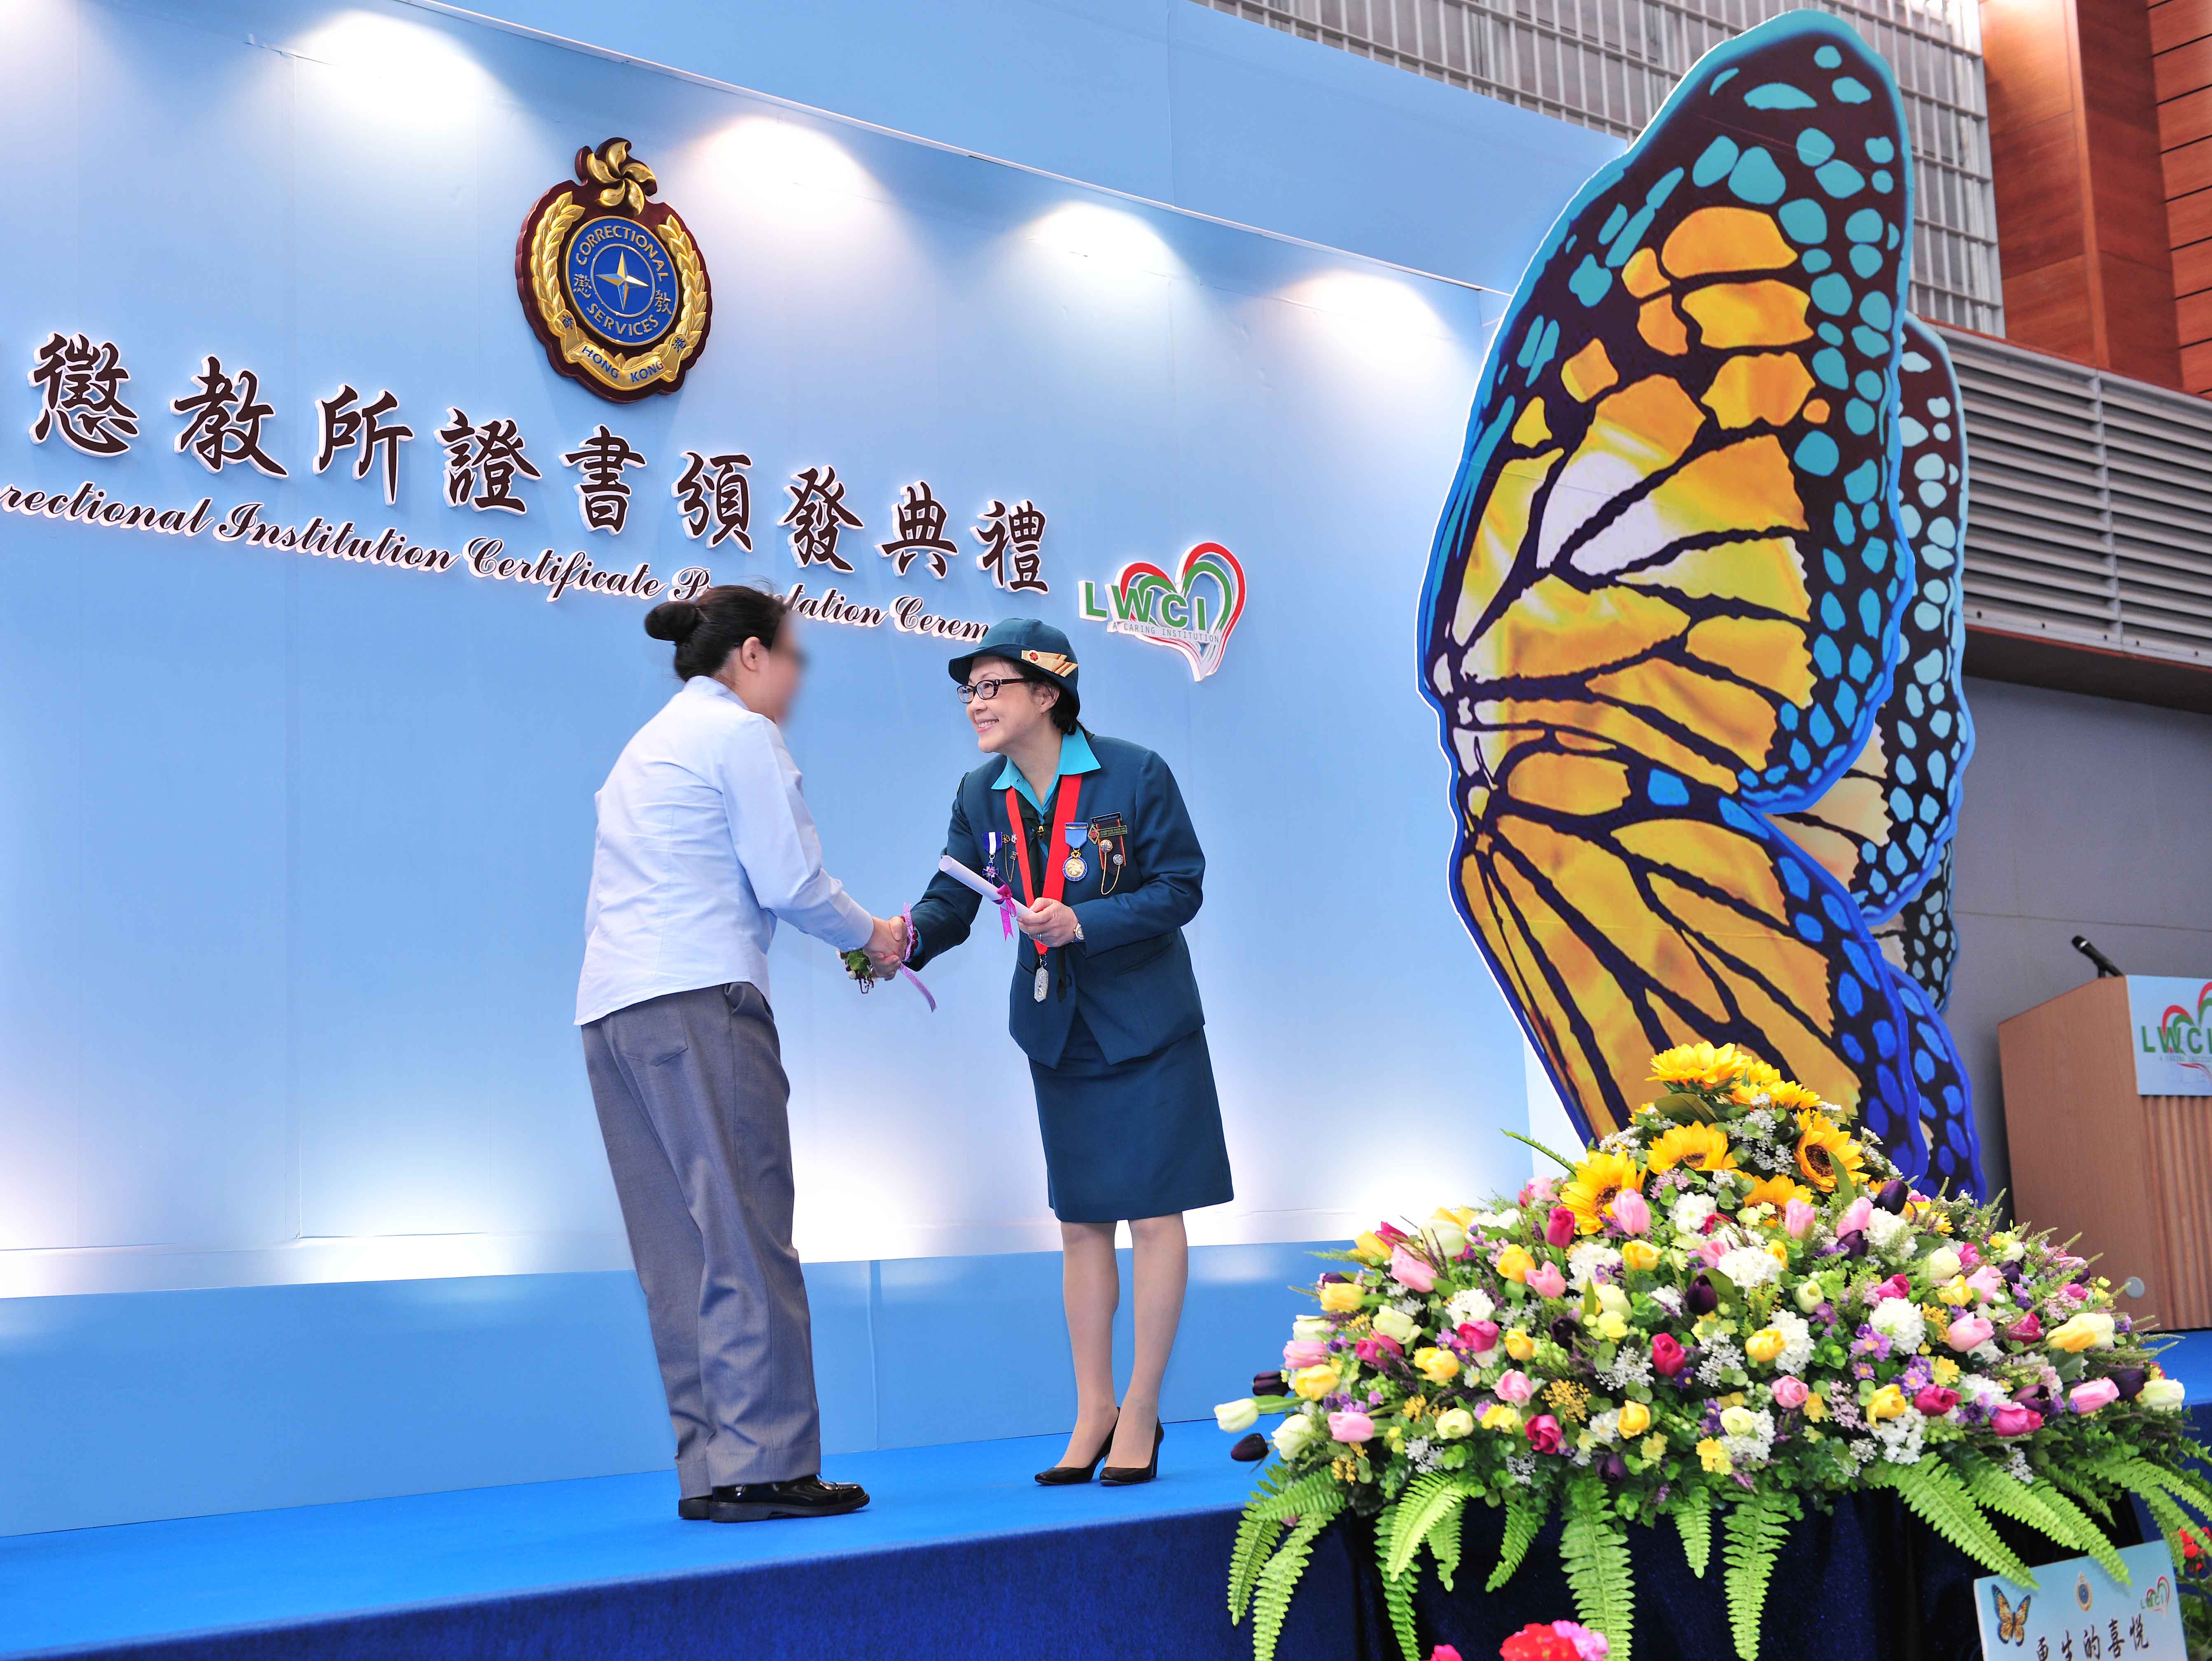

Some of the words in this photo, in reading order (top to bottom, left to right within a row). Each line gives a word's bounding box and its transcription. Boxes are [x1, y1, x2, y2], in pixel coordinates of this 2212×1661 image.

[576, 225, 669, 282] CORRECTIONAL
[587, 303, 659, 337] SERVICES
[655, 290, 672, 315] 教
[582, 346, 619, 379] HONG
[630, 359, 664, 384] KONG
[213, 503, 461, 571] Institution
[463, 536, 667, 602] Certificate
[668, 566, 889, 628] Ptation
[890, 596, 989, 643] Cerem
[1079, 580, 1208, 632] LWCI
[1124, 622, 1156, 635] CARING
[1162, 628, 1219, 643] INSTITUTION
[2141, 1025, 2212, 1054] LWCI
